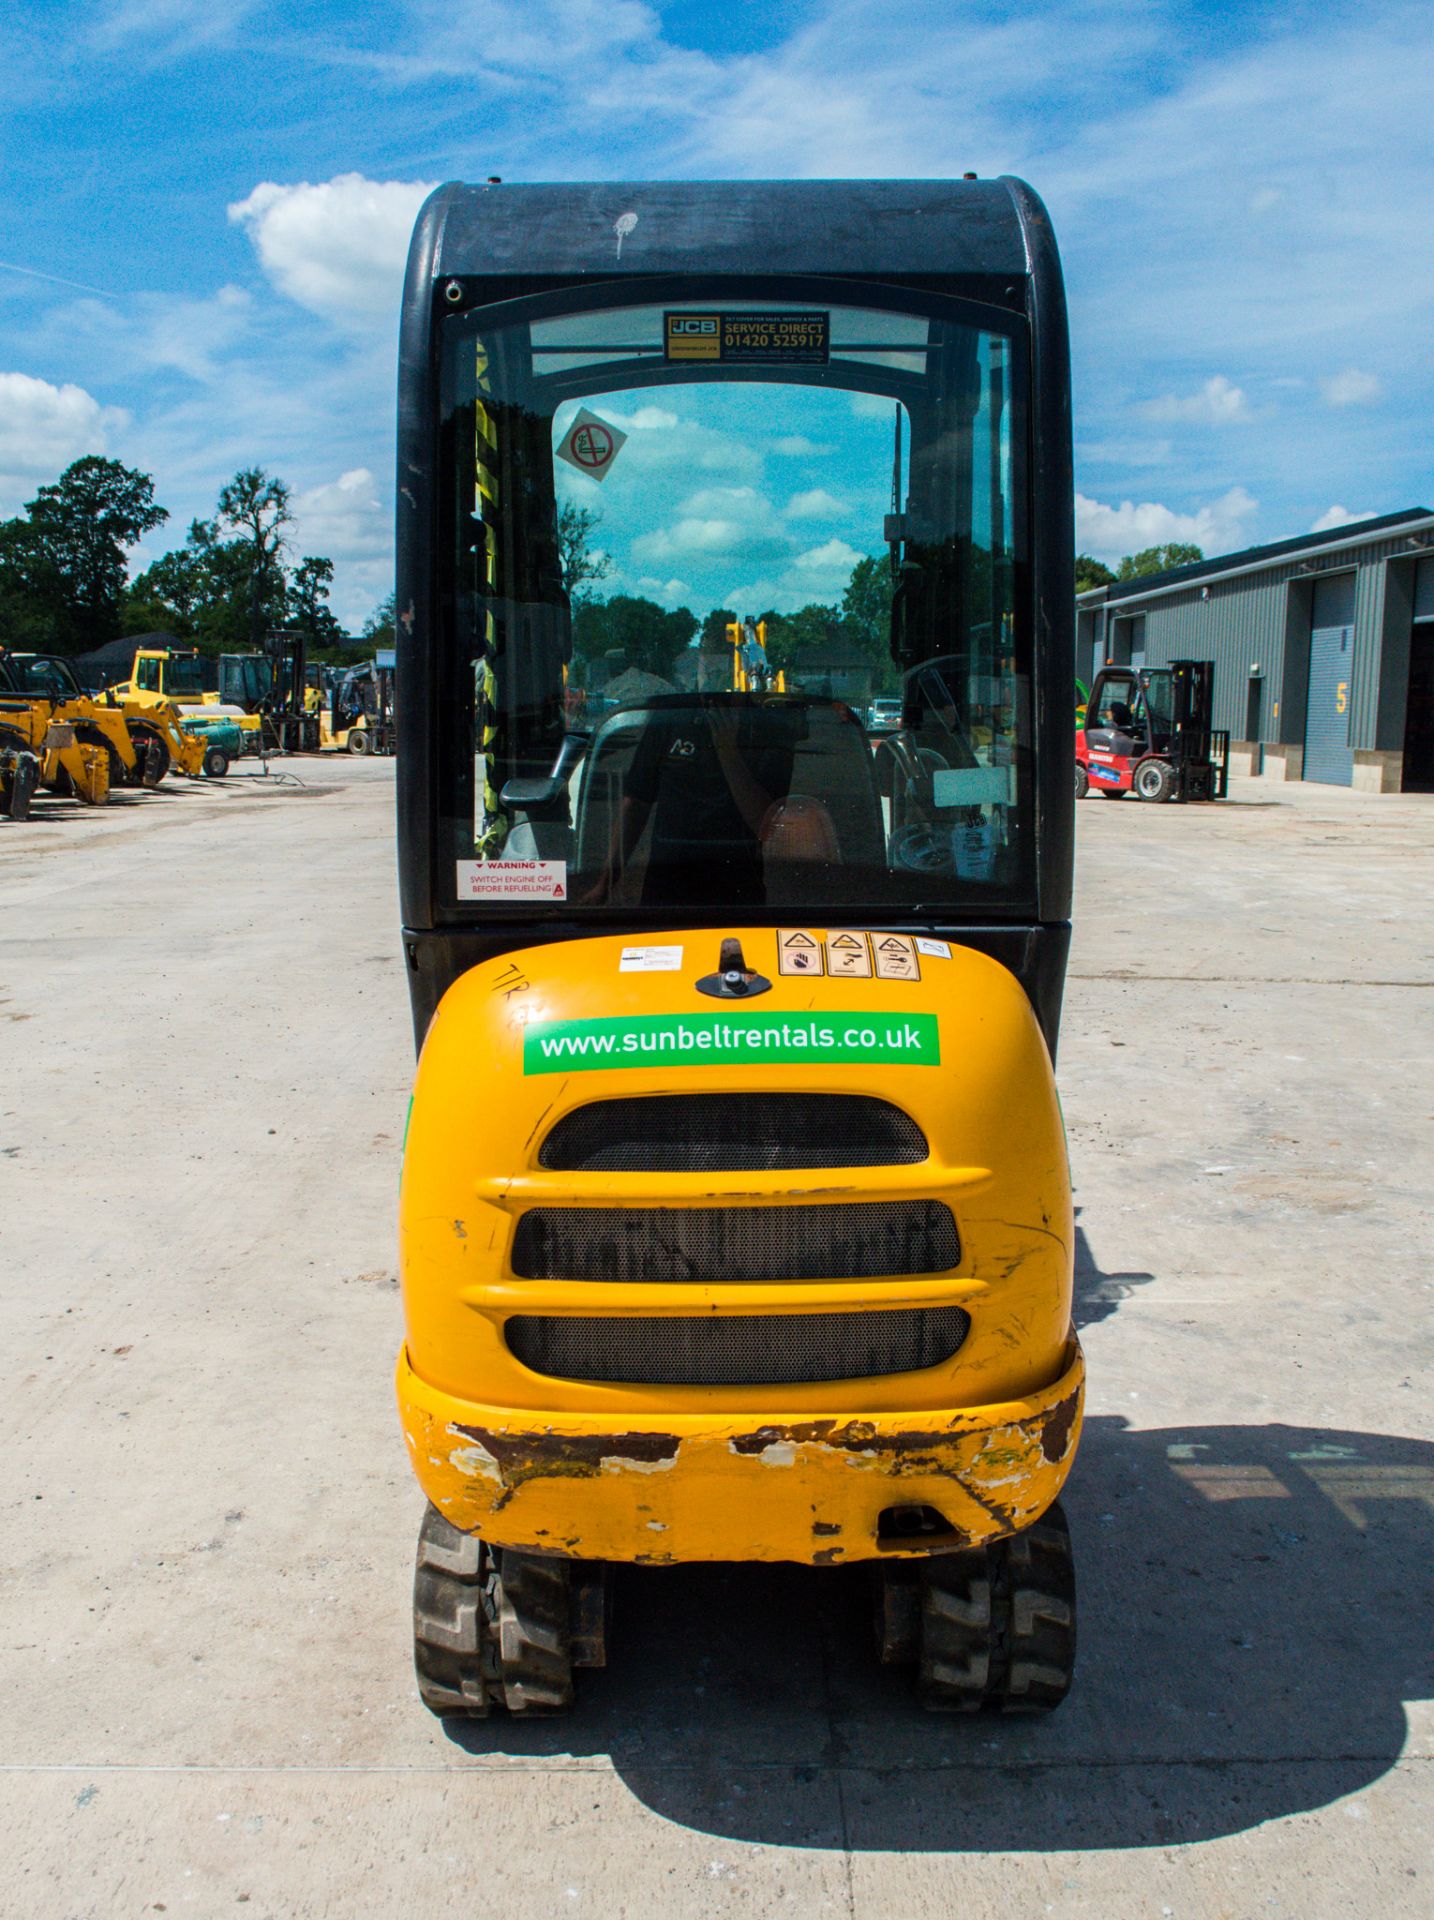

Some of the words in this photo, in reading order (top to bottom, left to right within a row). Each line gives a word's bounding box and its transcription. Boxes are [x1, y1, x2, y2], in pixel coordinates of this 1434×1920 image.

[672, 320, 717, 333] JCB
[725, 324, 776, 333] SERVICE
[780, 324, 824, 333] DIRECT
[725, 335, 768, 347] 01420
[772, 335, 823, 347] 525917
[1336, 681, 1348, 713] 5
[470, 875, 502, 883] SWITCH
[505, 875, 535, 883] ENGINE
[537, 875, 553, 883] OFF
[472, 885, 502, 893] BEFORE
[540, 1022, 922, 1057] www.sunbeltrentals.co.uk
